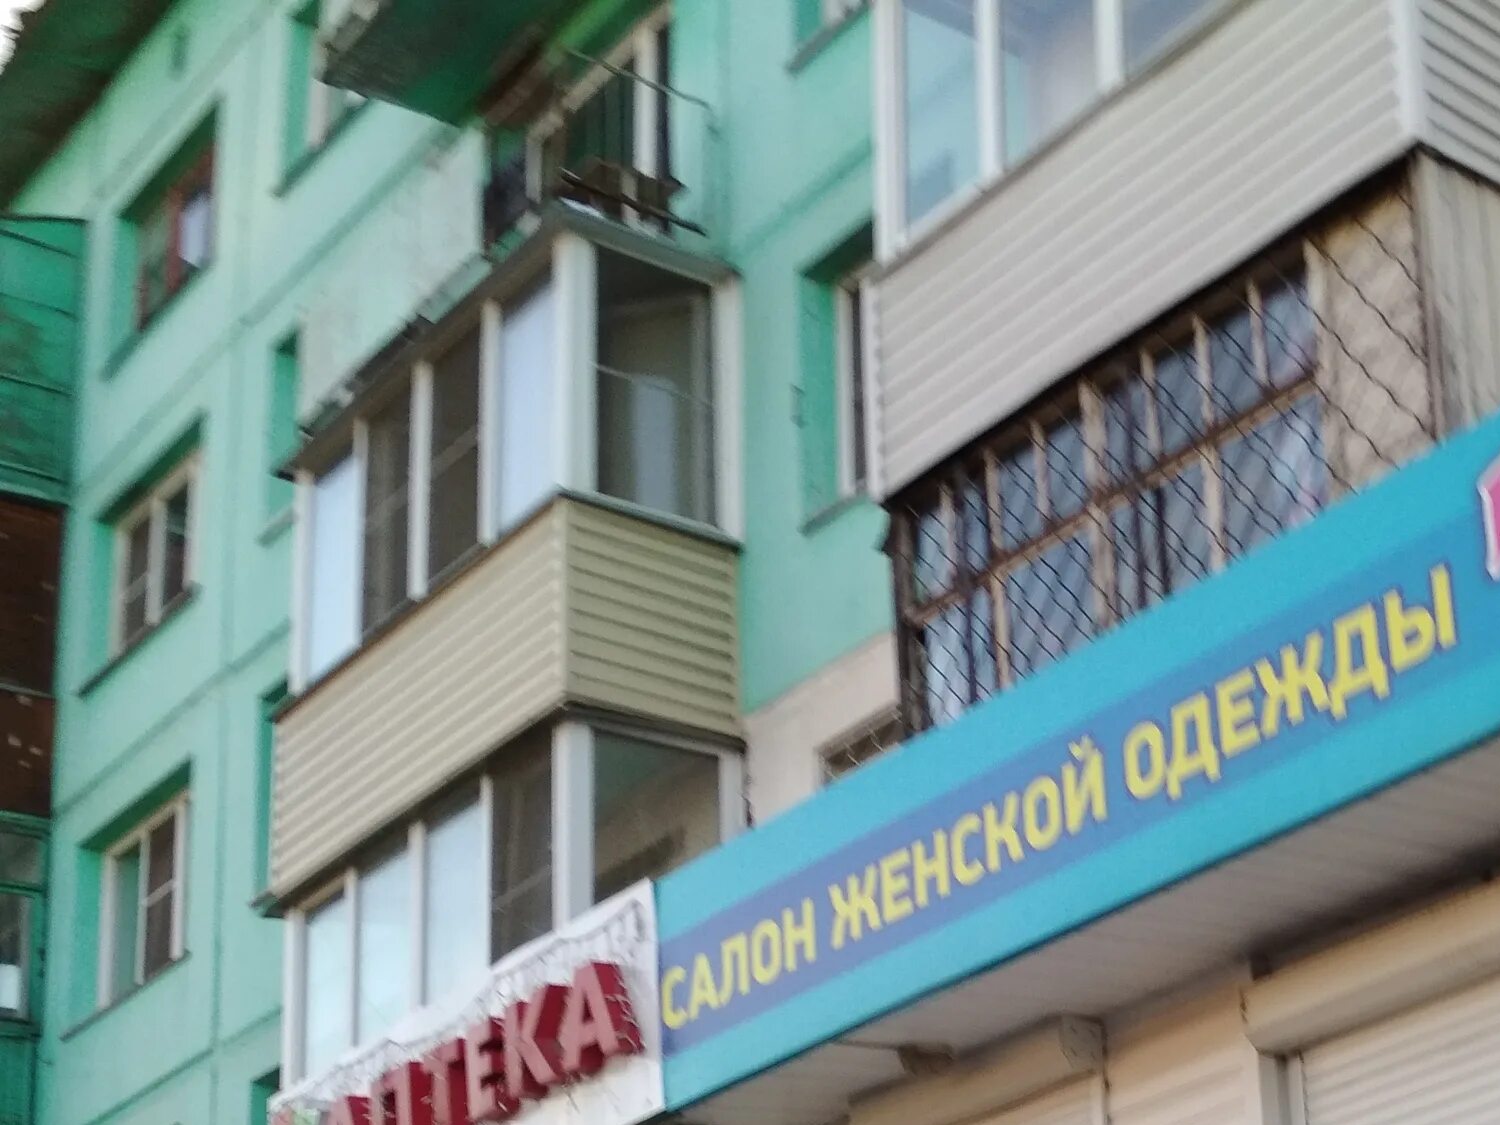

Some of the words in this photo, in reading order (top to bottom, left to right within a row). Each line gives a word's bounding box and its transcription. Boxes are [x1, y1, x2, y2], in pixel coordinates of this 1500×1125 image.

[659, 896, 817, 1030] САЛОН
[828, 734, 1108, 950] ЖЕНСКОЙ
[1122, 563, 1457, 802] ОДЕЖДЫ
